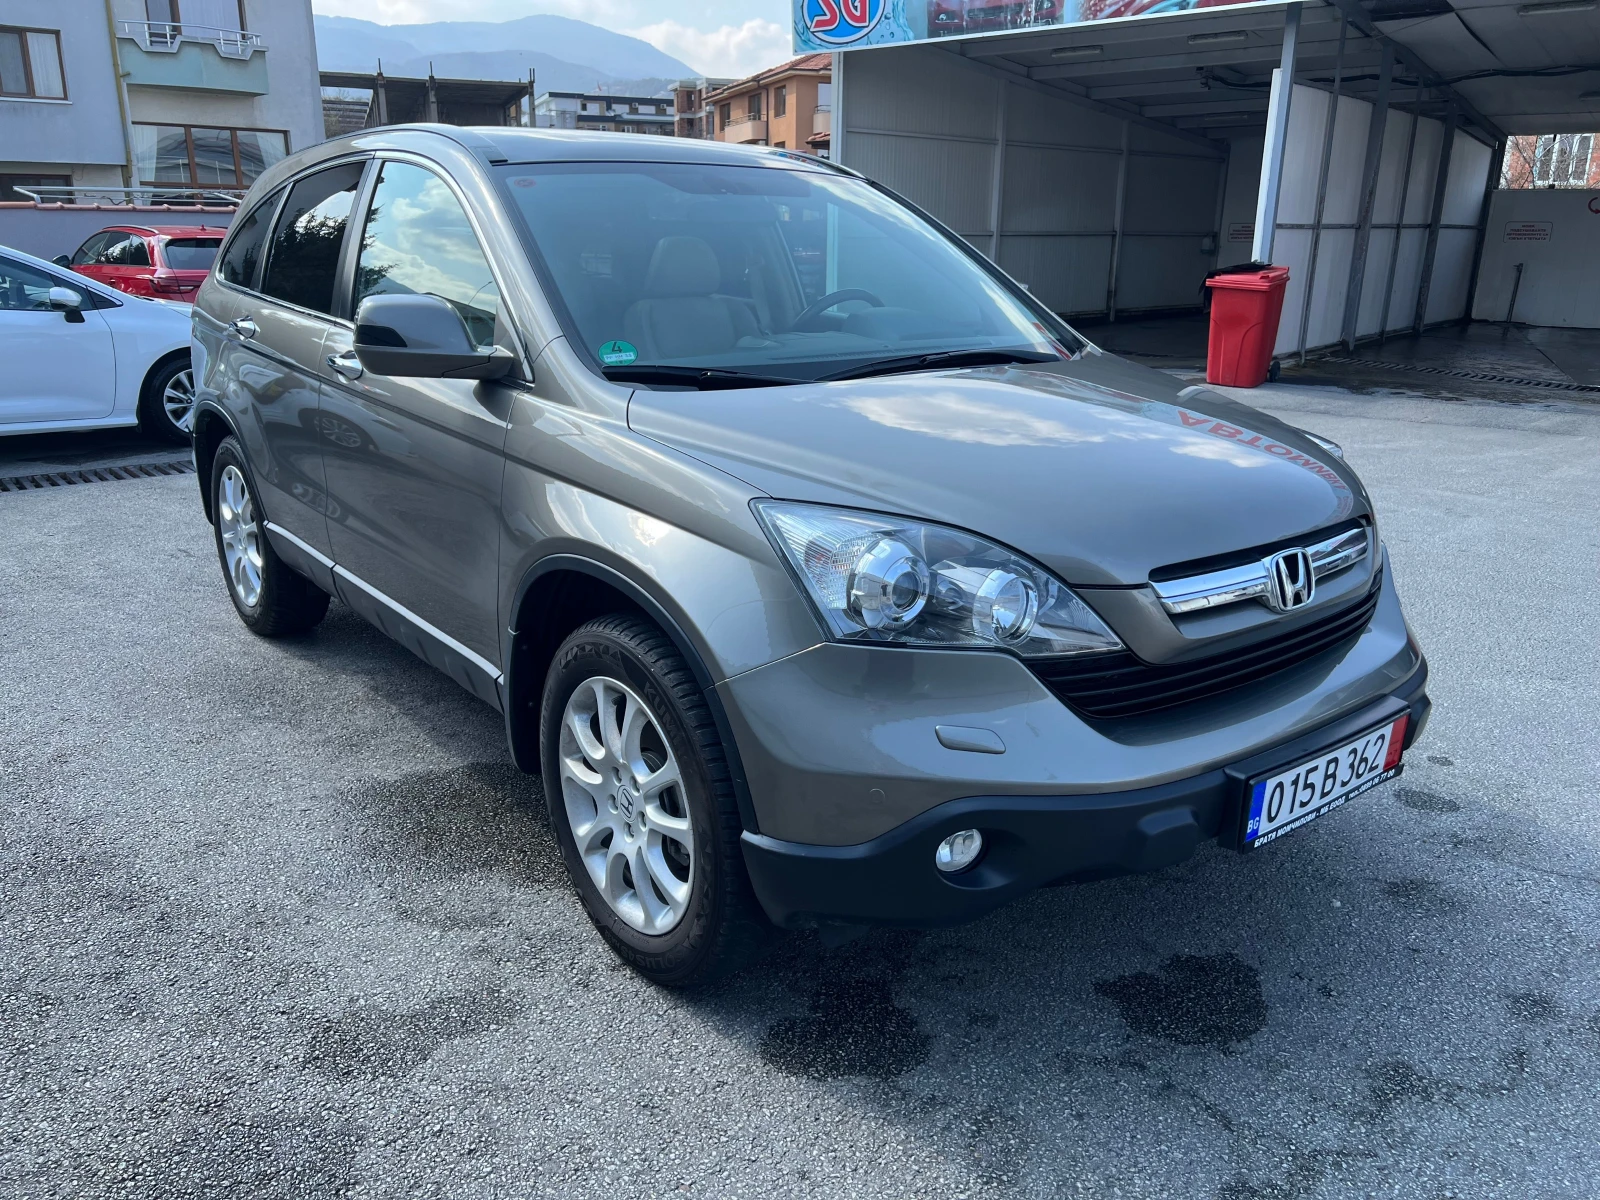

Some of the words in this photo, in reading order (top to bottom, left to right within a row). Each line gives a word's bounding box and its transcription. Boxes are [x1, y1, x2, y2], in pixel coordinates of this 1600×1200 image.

[611, 341, 623, 353] 4
[1247, 816, 1260, 833] BG
[1254, 831, 1277, 848] БРАТЯ
